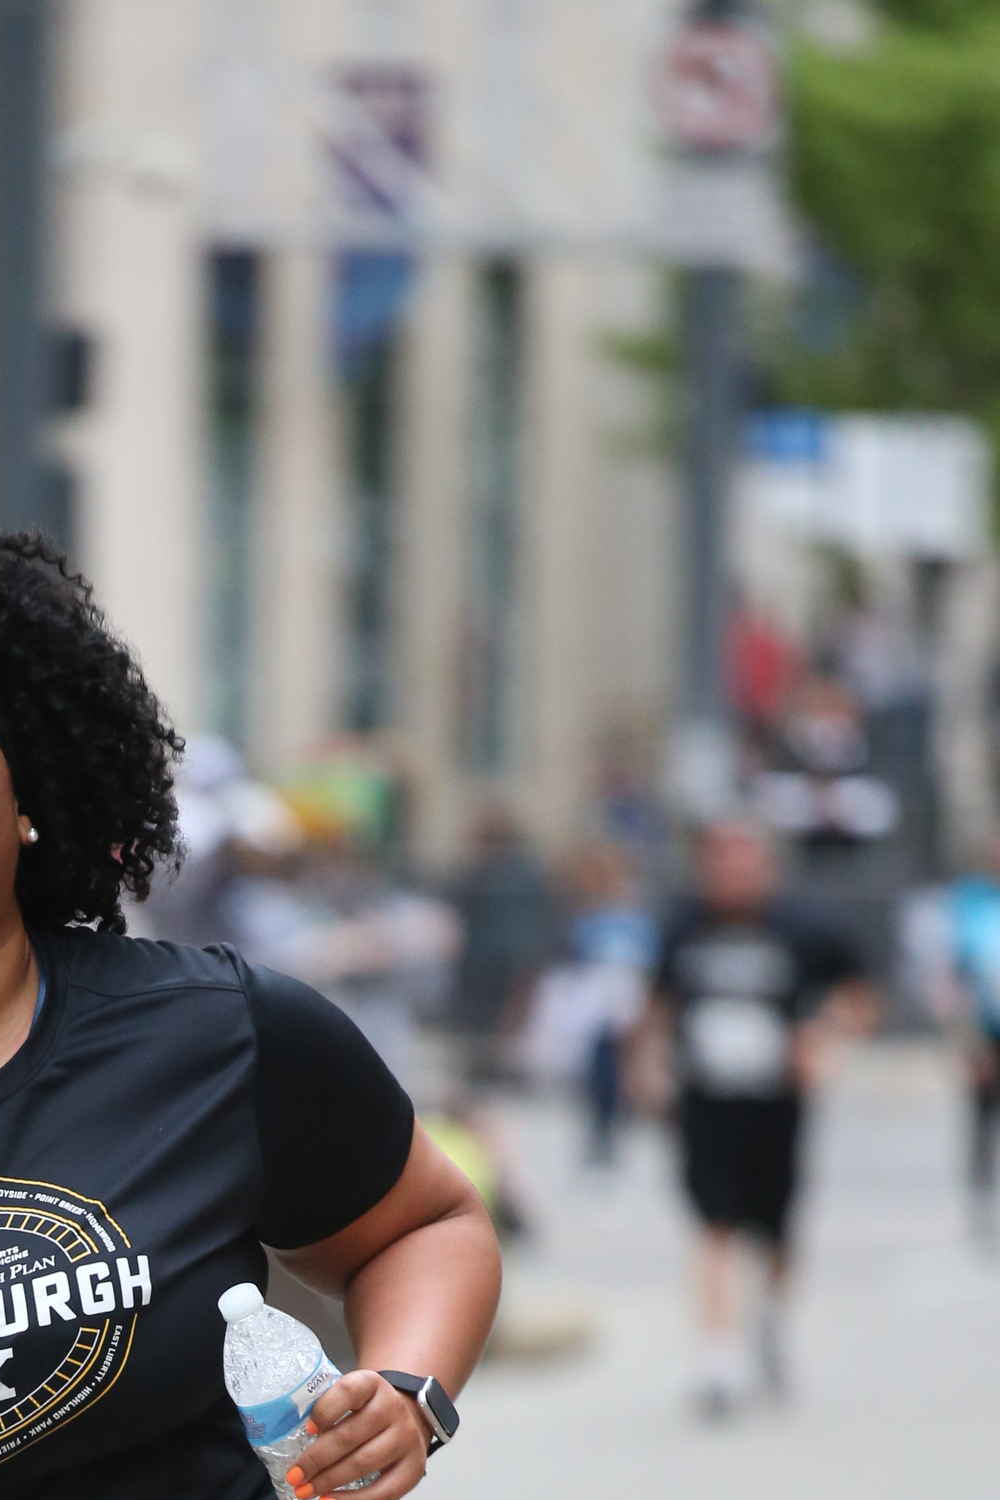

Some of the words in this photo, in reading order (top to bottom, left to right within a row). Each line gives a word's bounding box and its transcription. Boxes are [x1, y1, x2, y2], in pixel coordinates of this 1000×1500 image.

[34, 1192, 61, 1206] POINT
[85, 1212, 117, 1253] HOMEWOOD
[9, 1254, 56, 1280] PLAN
[110, 1324, 123, 1347] EAST
[94, 1347, 116, 1383] LIBERTY
[53, 1385, 93, 1420] HIGHLAND
[28, 1417, 53, 1437] PARK
